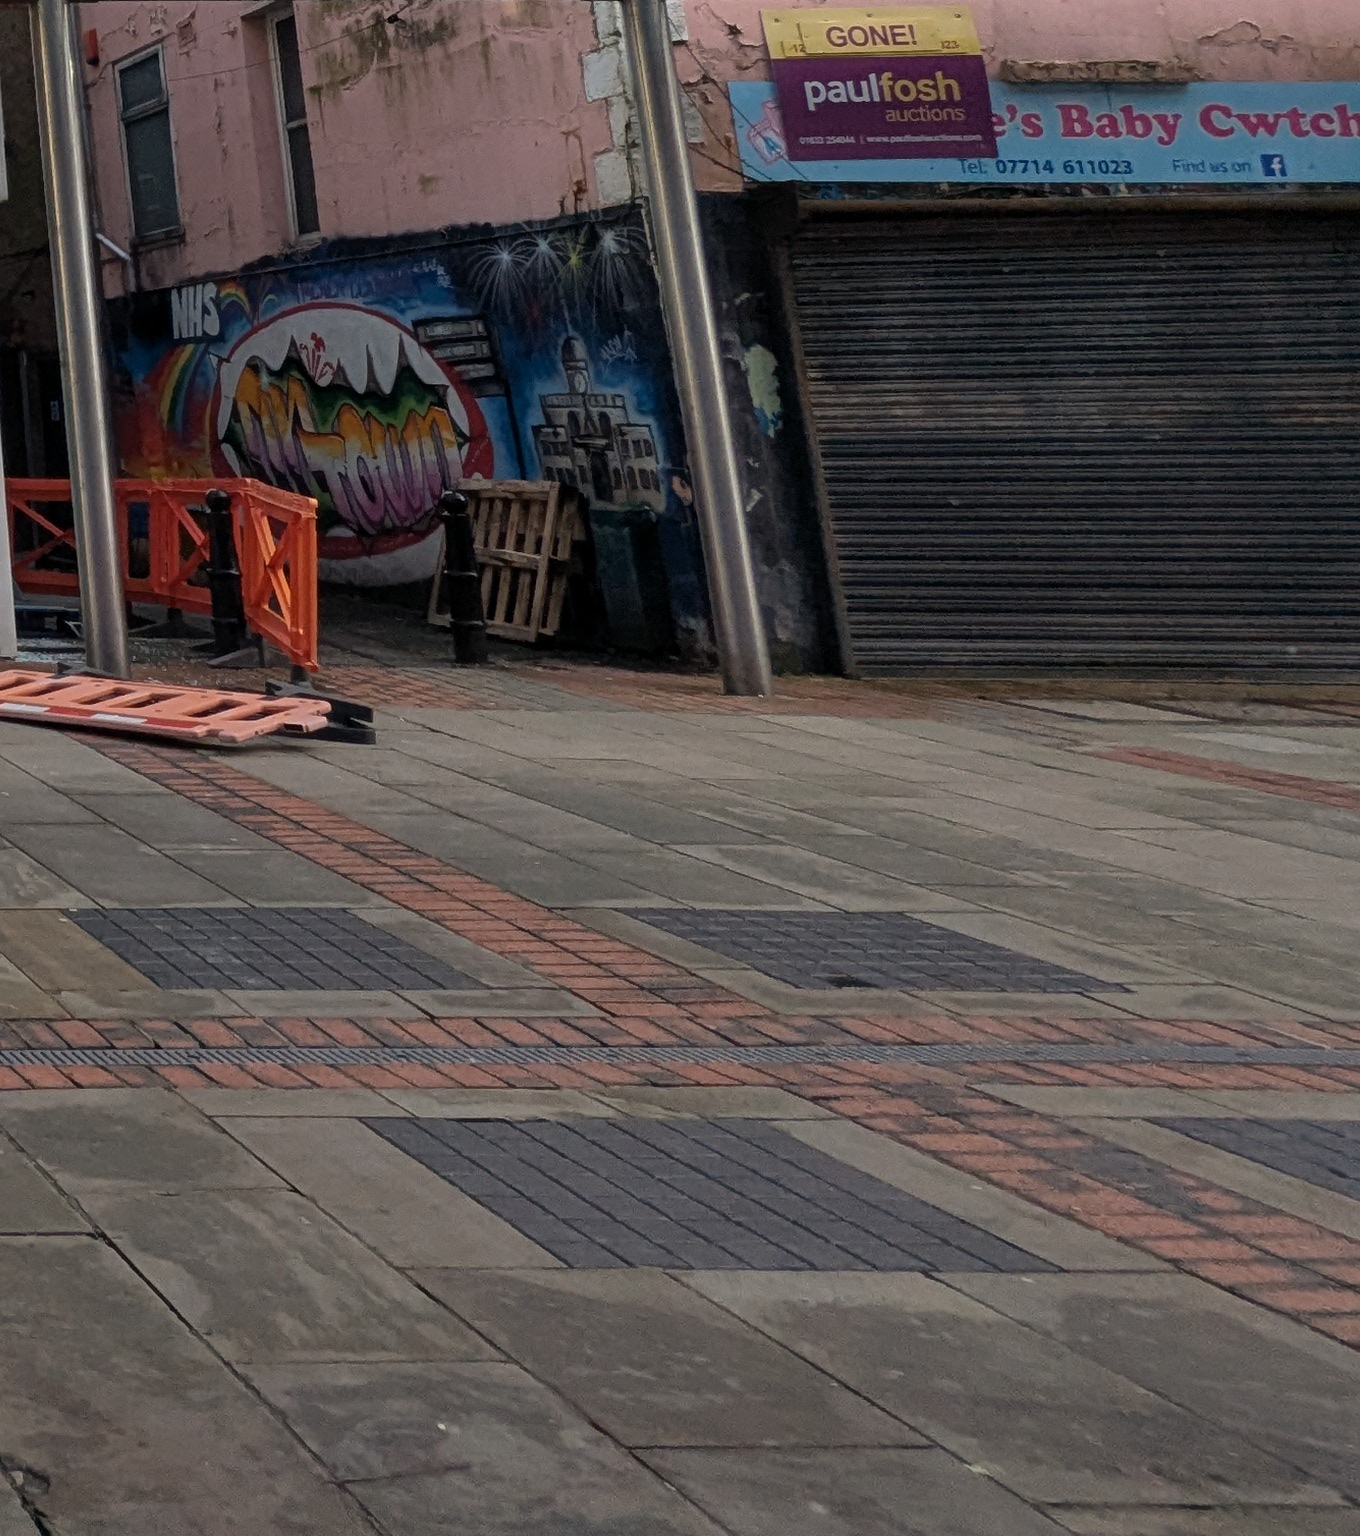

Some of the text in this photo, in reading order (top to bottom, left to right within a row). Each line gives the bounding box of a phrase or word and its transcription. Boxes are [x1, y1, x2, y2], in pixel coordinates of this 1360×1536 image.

[826, 24, 917, 48] GONE!
[885, 104, 966, 122] auctions
[1055, 103, 1182, 146] Baby
[1199, 103, 1360, 138] Cwtch
[960, 159, 1134, 175] Tel: 07714 611023
[1172, 158, 1206, 174] Find
[1210, 162, 1228, 174] us
[1231, 162, 1252, 174] on
[171, 282, 220, 340] NHS
